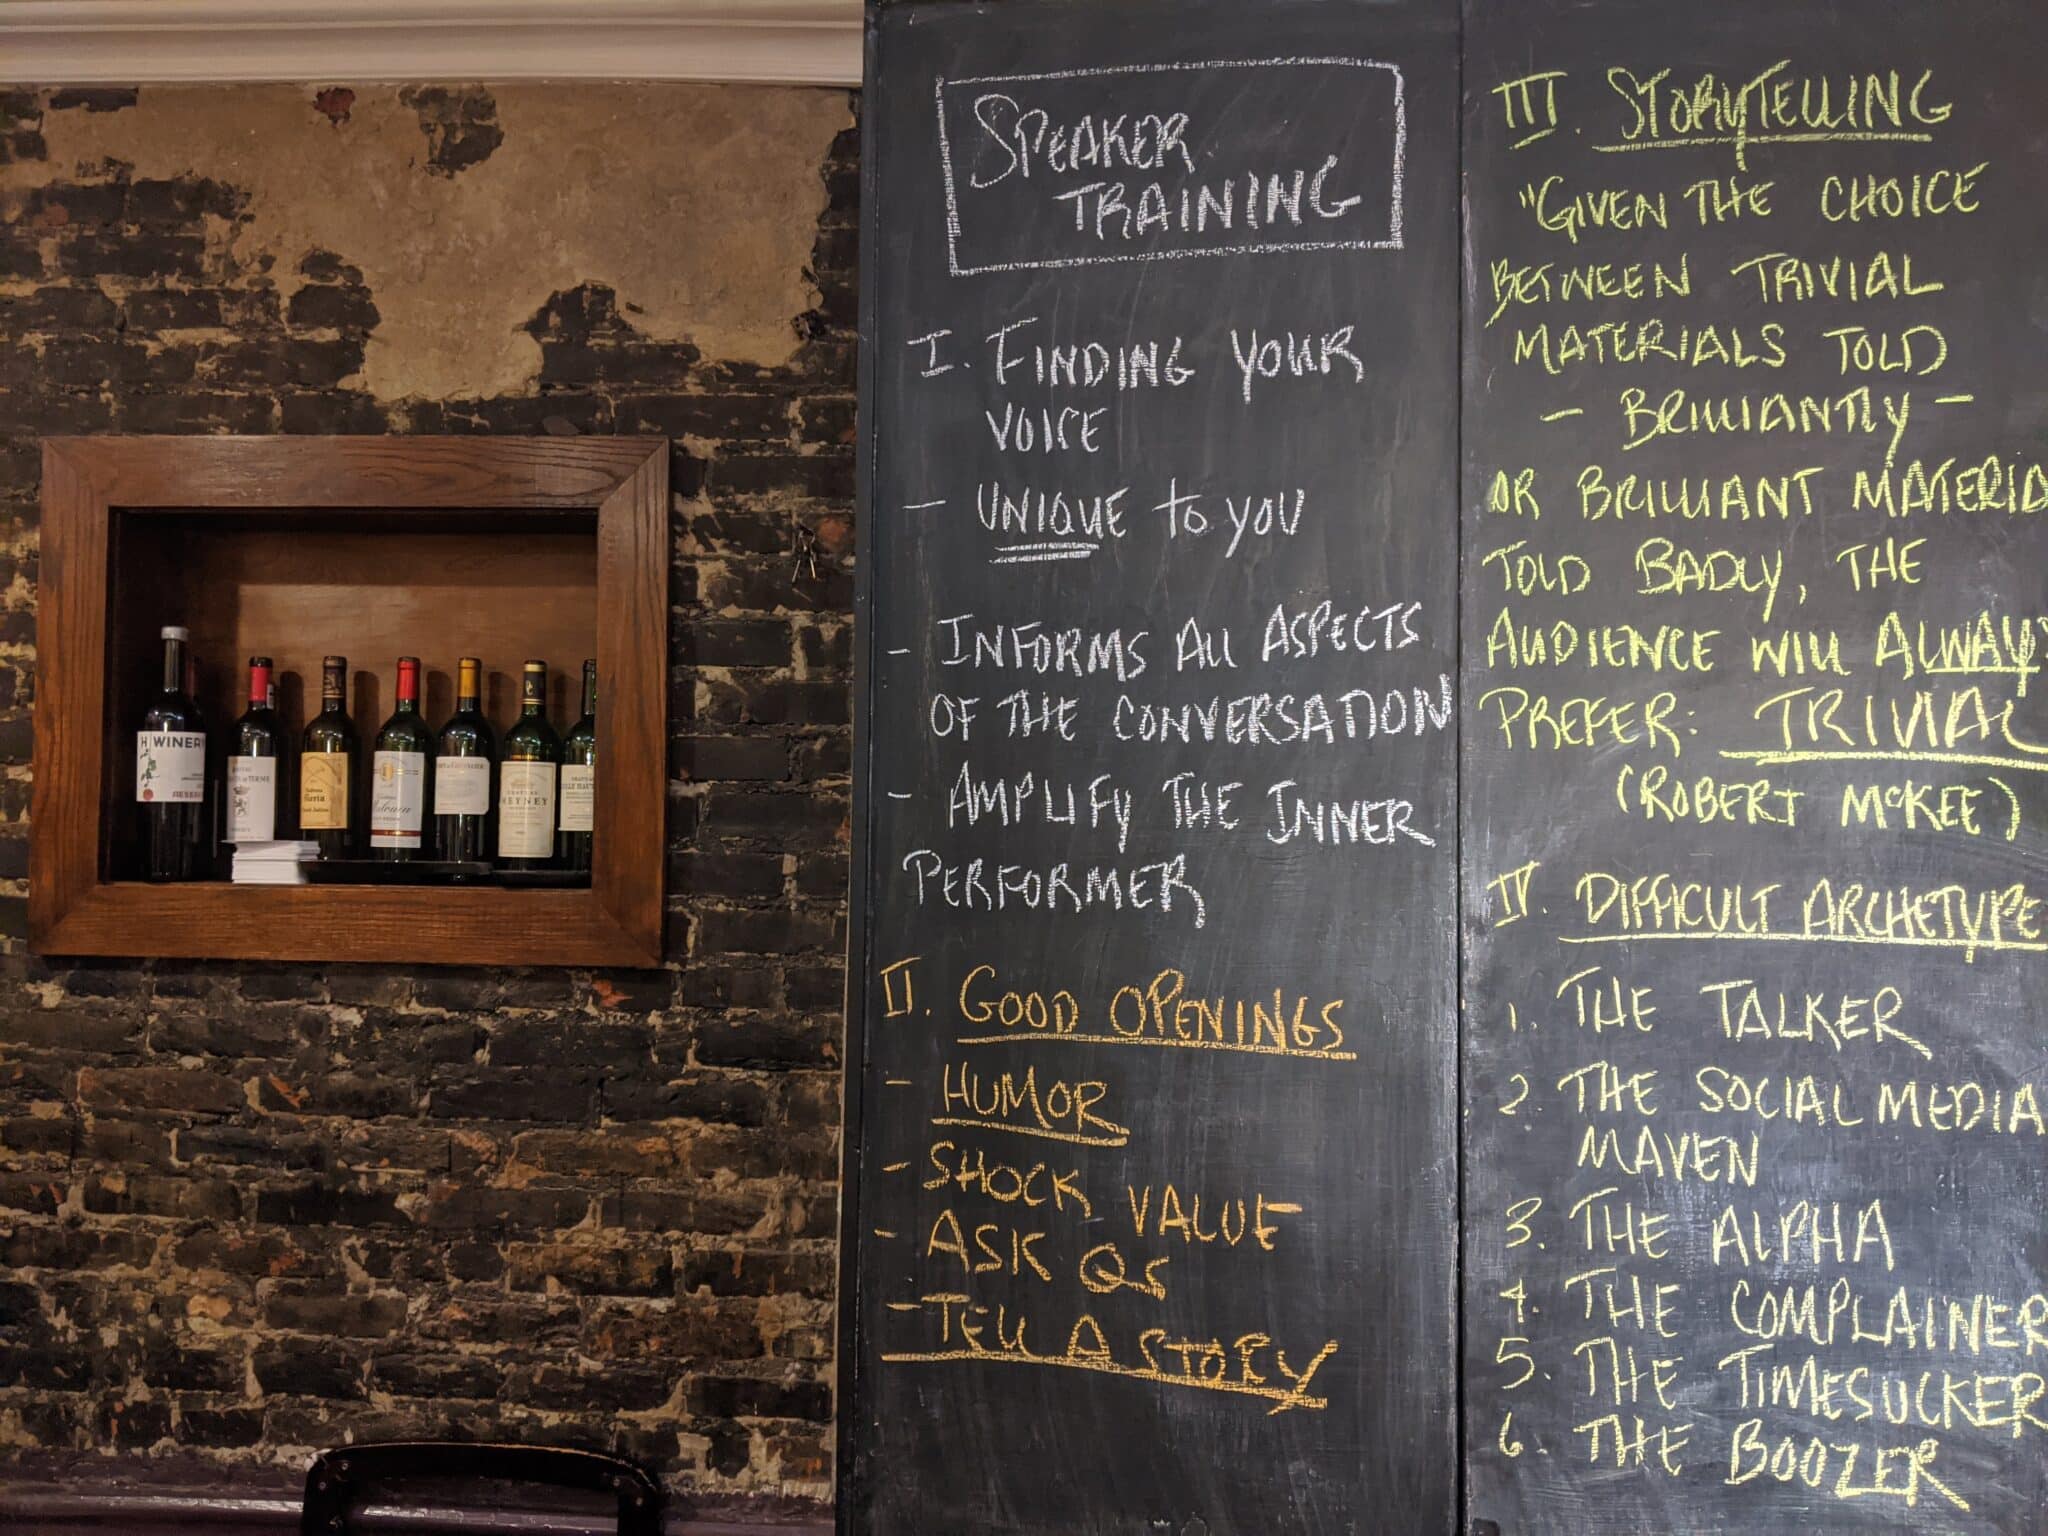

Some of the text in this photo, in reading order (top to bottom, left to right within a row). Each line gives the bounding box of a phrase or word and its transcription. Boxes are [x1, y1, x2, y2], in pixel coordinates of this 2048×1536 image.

[970, 93, 1194, 188] SPEAKER
[1491, 59, 1953, 171] III. STORYTELLING
[1053, 154, 1360, 240] TRAINING
[1518, 161, 1990, 244] "GIVEN THE CHOICE
[1483, 251, 1944, 329] BETWEEN TRIVIAL
[907, 317, 1365, 404] I. FINDING YOUR
[1514, 318, 1948, 376] MATERIALS TOLD
[985, 402, 1108, 454] VOICE
[978, 481, 1129, 539] UNIQUE
[1487, 467, 1541, 520] OR
[1577, 466, 1825, 521] BRILLIANT
[1482, 541, 1592, 596] TOLD
[1837, 537, 1928, 592] THE
[937, 613, 1150, 682] INFORMS
[1176, 616, 1237, 671] ALL
[1262, 600, 1422, 662] ASPECTS
[1487, 607, 1722, 671] AUDIENCE
[1752, 630, 1852, 677] WILL
[930, 673, 1453, 745] OF THE CONVERSATION
[1754, 686, 2048, 756] TRIVIAL
[1161, 771, 1244, 830] THE
[1265, 778, 1437, 848] INNER
[1617, 764, 1805, 824] (ROBERT
[902, 849, 1206, 930] PERFORMER
[1487, 860, 2041, 963] IV. DIFFICULT ARCHETYPE
[880, 956, 1345, 1050] II. GOOD OPENINGS
[1508, 967, 1933, 1060] 1. THE TALKER
[943, 1061, 1130, 1136] HUMOR
[1498, 1061, 2046, 1136] 2. THE SOCIAL MEDIA
[1577, 1125, 1759, 1186] MAVEN
[923, 1139, 1092, 1218] SHOCK
[1127, 1182, 1302, 1252] VALUE
[1505, 1187, 1894, 1271] 3. THE ALPHA
[927, 1207, 1053, 1283] ASK
[921, 1293, 1029, 1357] TELL
[1066, 1313, 1110, 1359] A
[1500, 1267, 2048, 1356] 4. THE COMPLAINER
[1496, 1336, 2048, 1439] 5. THE TIMESUCKER
[1498, 1410, 1971, 1512] 6. THE BOOZER
